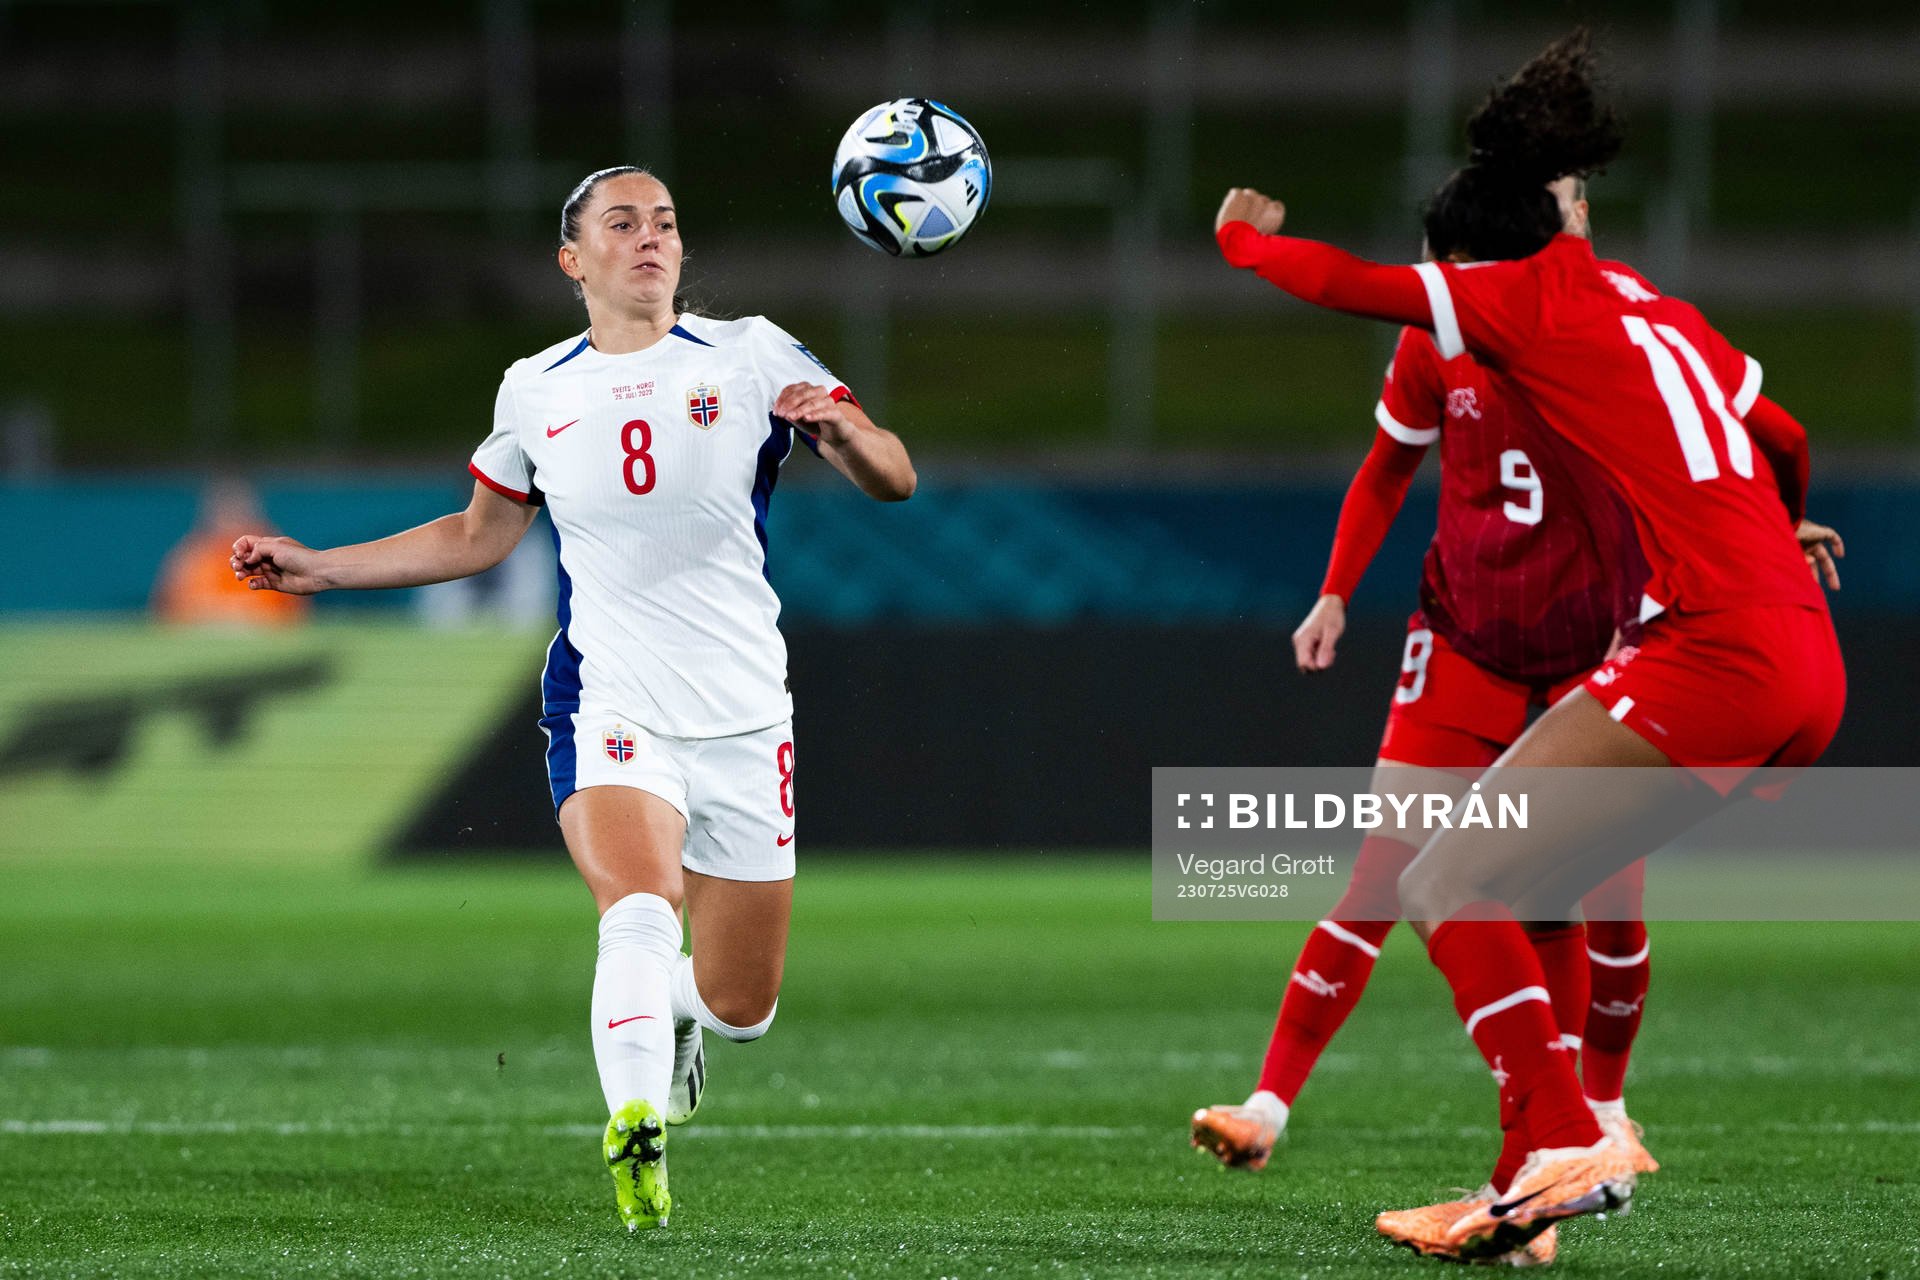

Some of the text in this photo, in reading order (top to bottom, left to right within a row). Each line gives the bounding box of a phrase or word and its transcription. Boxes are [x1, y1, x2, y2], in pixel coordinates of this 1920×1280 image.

[636, 381, 655, 389] NORGE
[638, 389, 653, 397] 2023
[1621, 315, 1754, 482] 11
[621, 419, 656, 495] 8
[1500, 449, 1543, 525] 9
[1396, 628, 1434, 704] 9
[778, 741, 793, 818] 8
